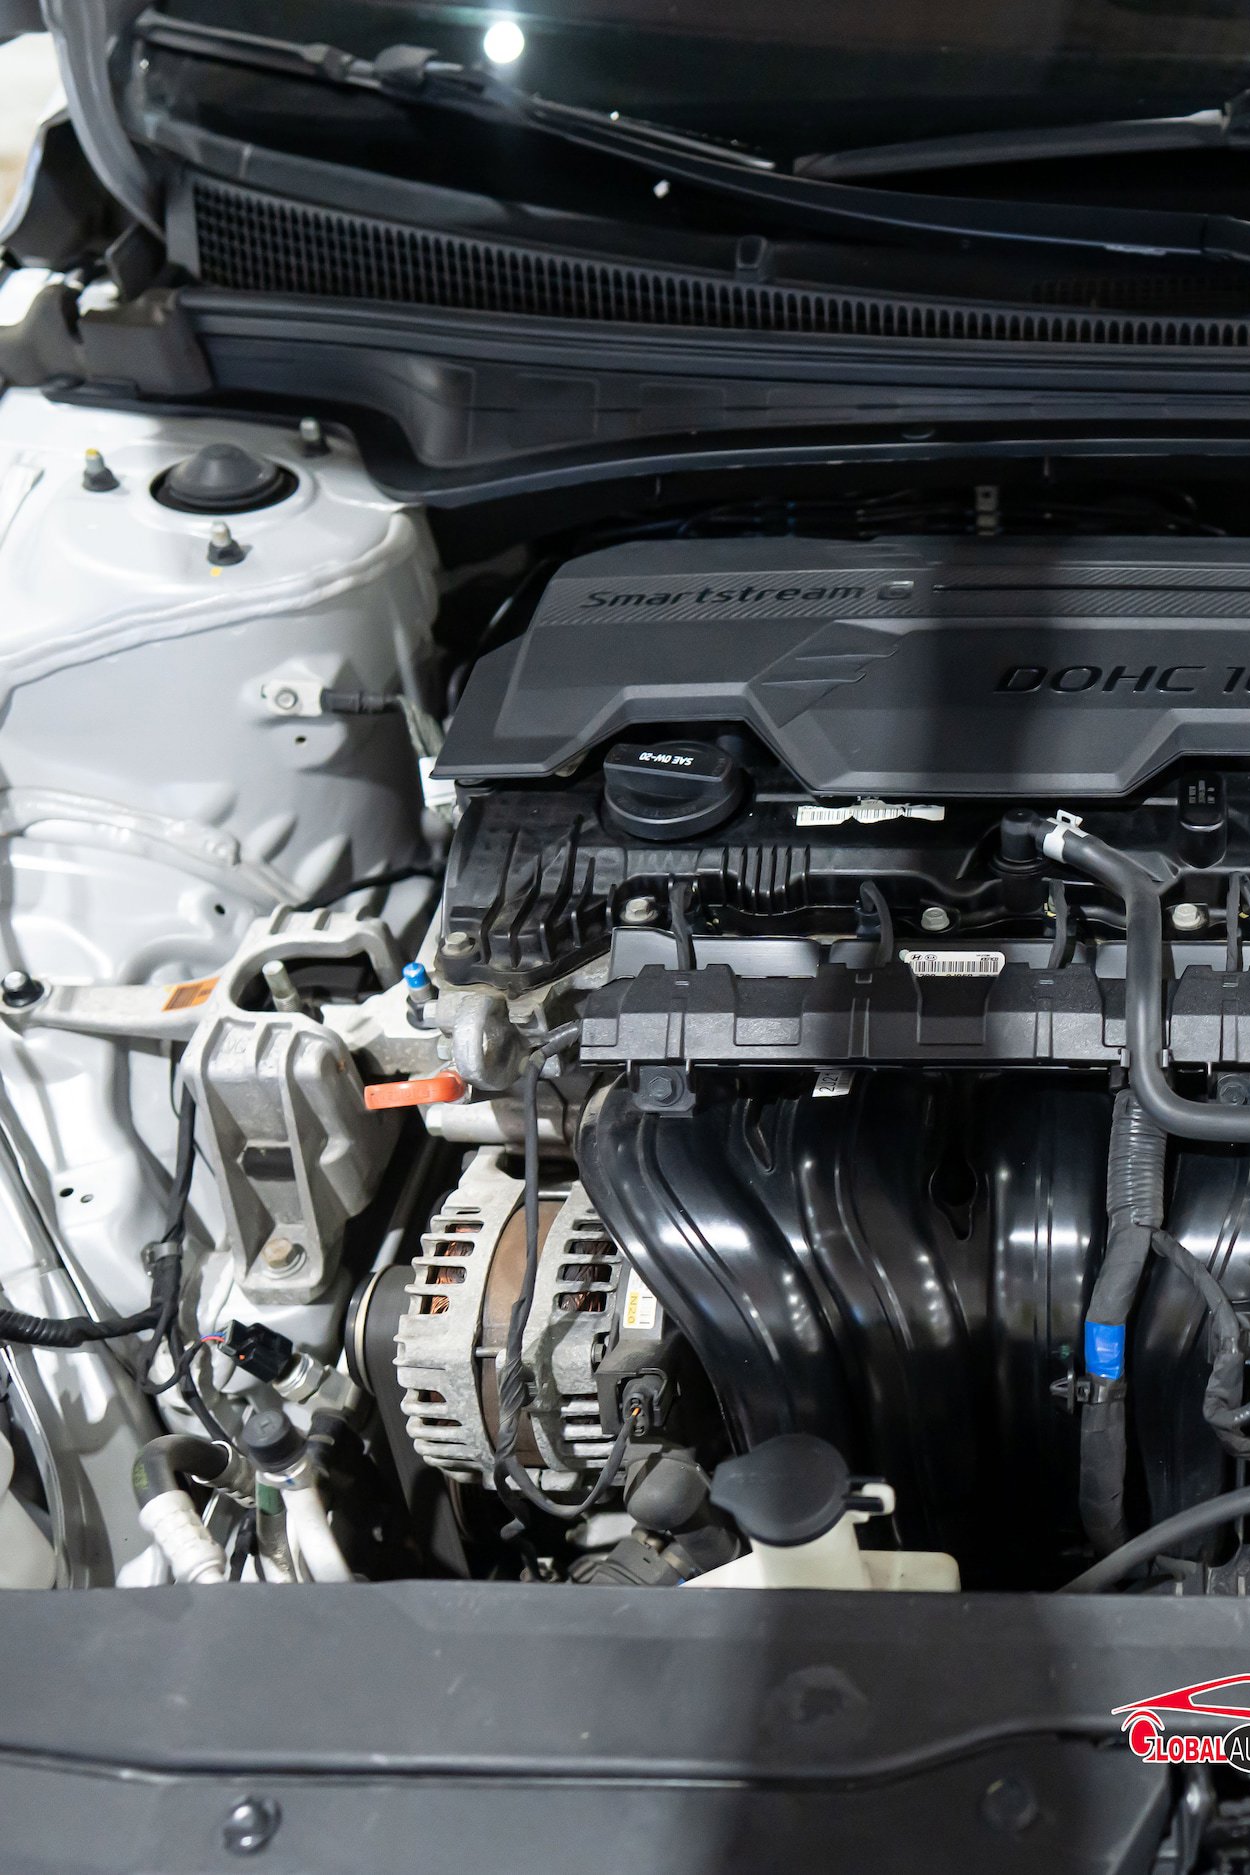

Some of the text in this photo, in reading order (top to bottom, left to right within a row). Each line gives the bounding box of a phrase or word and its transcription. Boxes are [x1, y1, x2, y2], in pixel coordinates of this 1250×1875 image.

[581, 583, 866, 609] Smartstream
[993, 664, 1207, 694] DOHC
[638, 751, 694, 766] SAE 0W-20
